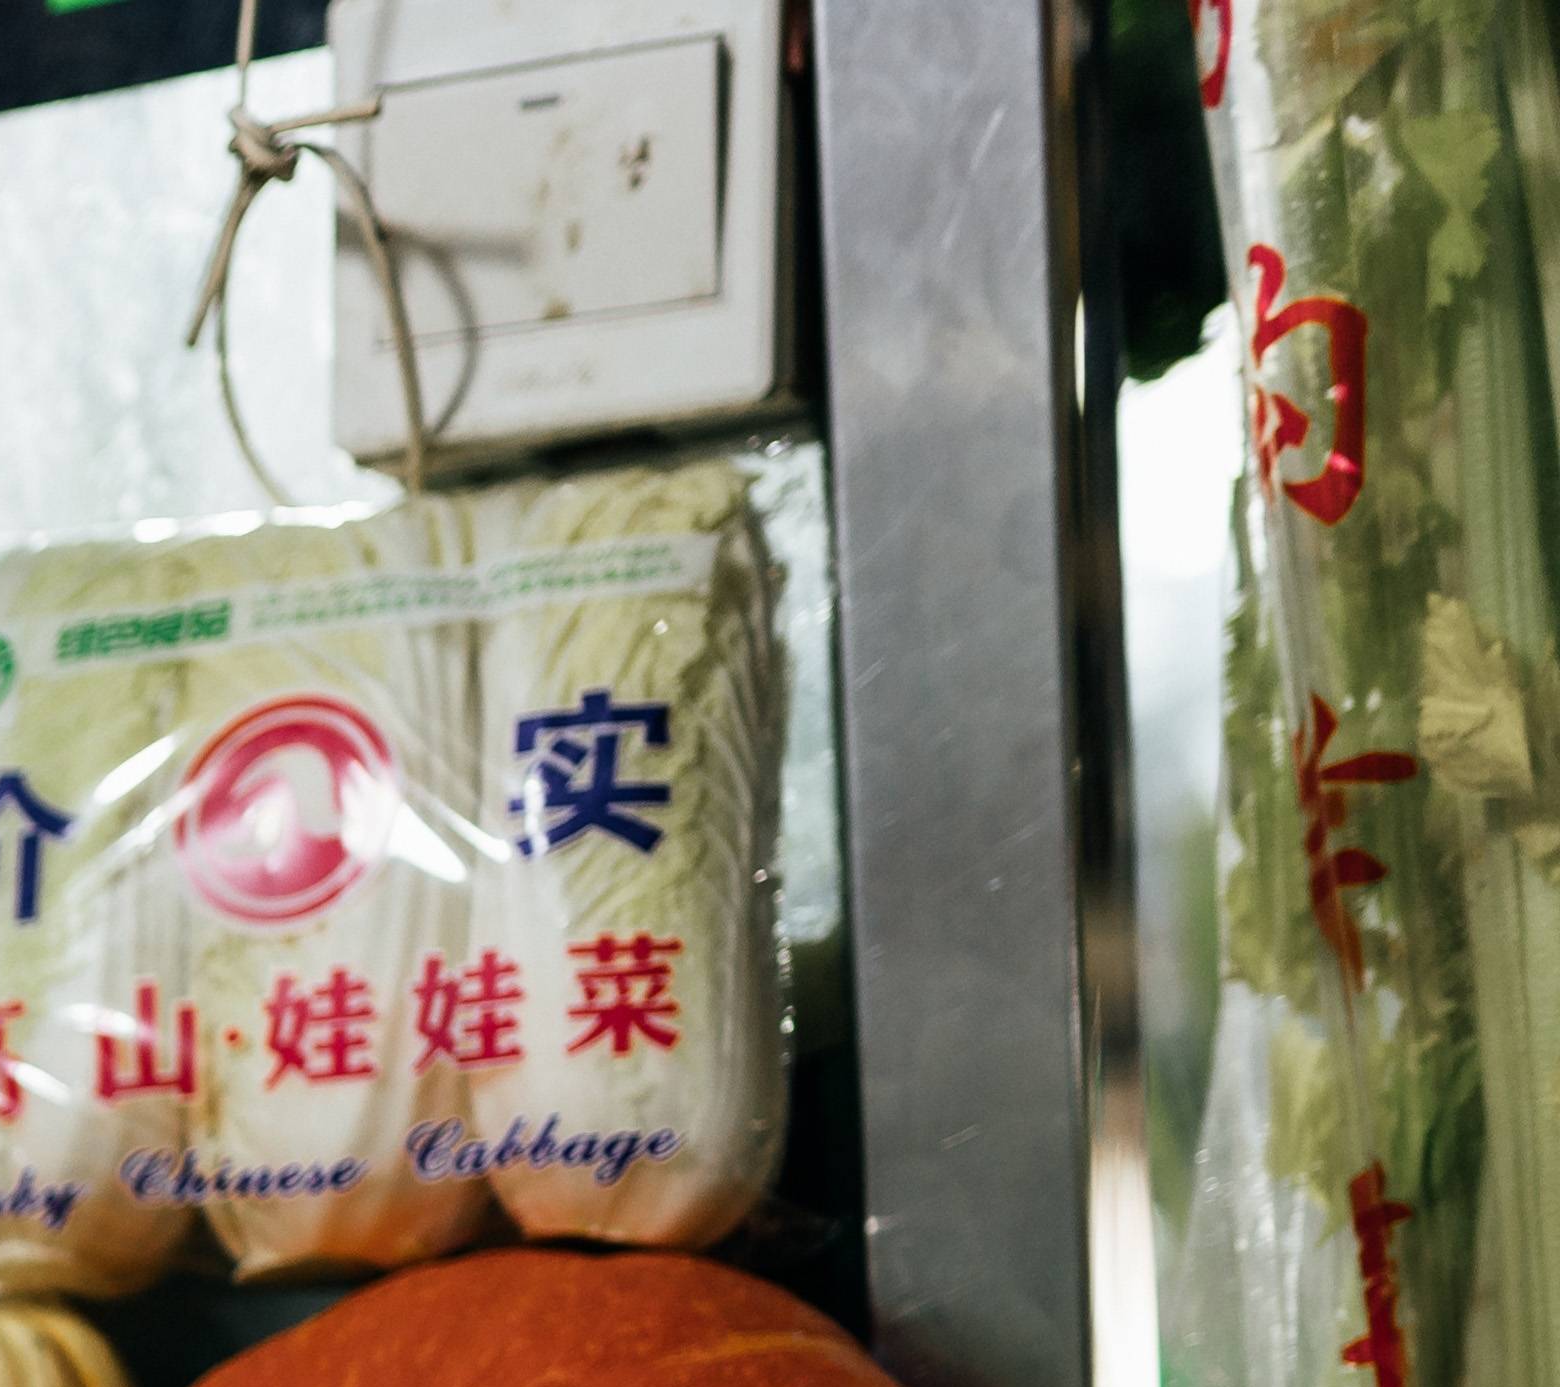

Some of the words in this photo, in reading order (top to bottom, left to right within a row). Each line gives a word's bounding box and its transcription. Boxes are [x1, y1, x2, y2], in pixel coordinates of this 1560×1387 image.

[507, 689, 671, 857] 实
[120, 1144, 370, 1201] Chinese
[405, 1112, 684, 1186] Cabbage
